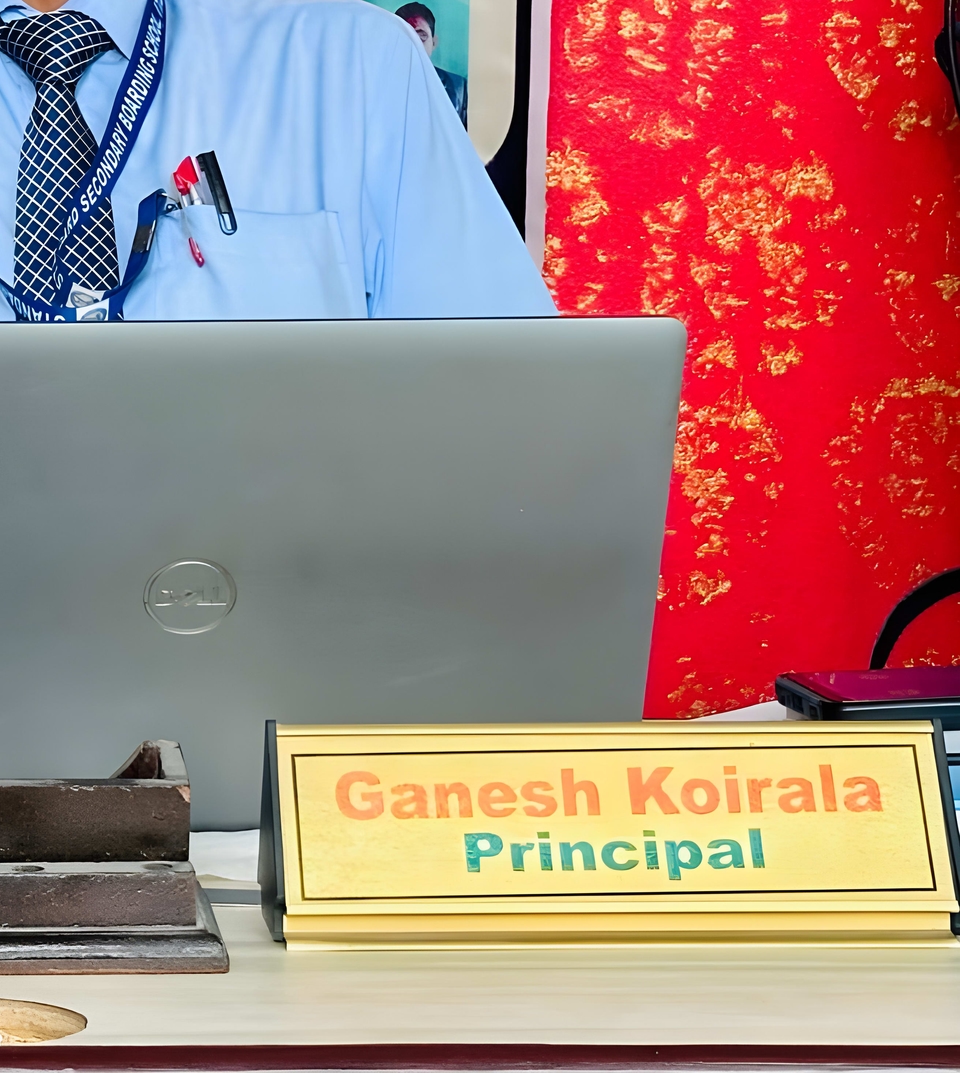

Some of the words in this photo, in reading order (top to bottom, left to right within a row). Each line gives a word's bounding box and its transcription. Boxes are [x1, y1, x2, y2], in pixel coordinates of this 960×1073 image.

[81, 128, 130, 212] SECONDARY
[119, 56, 155, 132] BOARDING
[335, 768, 600, 820] Ganesh
[627, 764, 883, 815] Koirala
[464, 828, 766, 881] Principal
